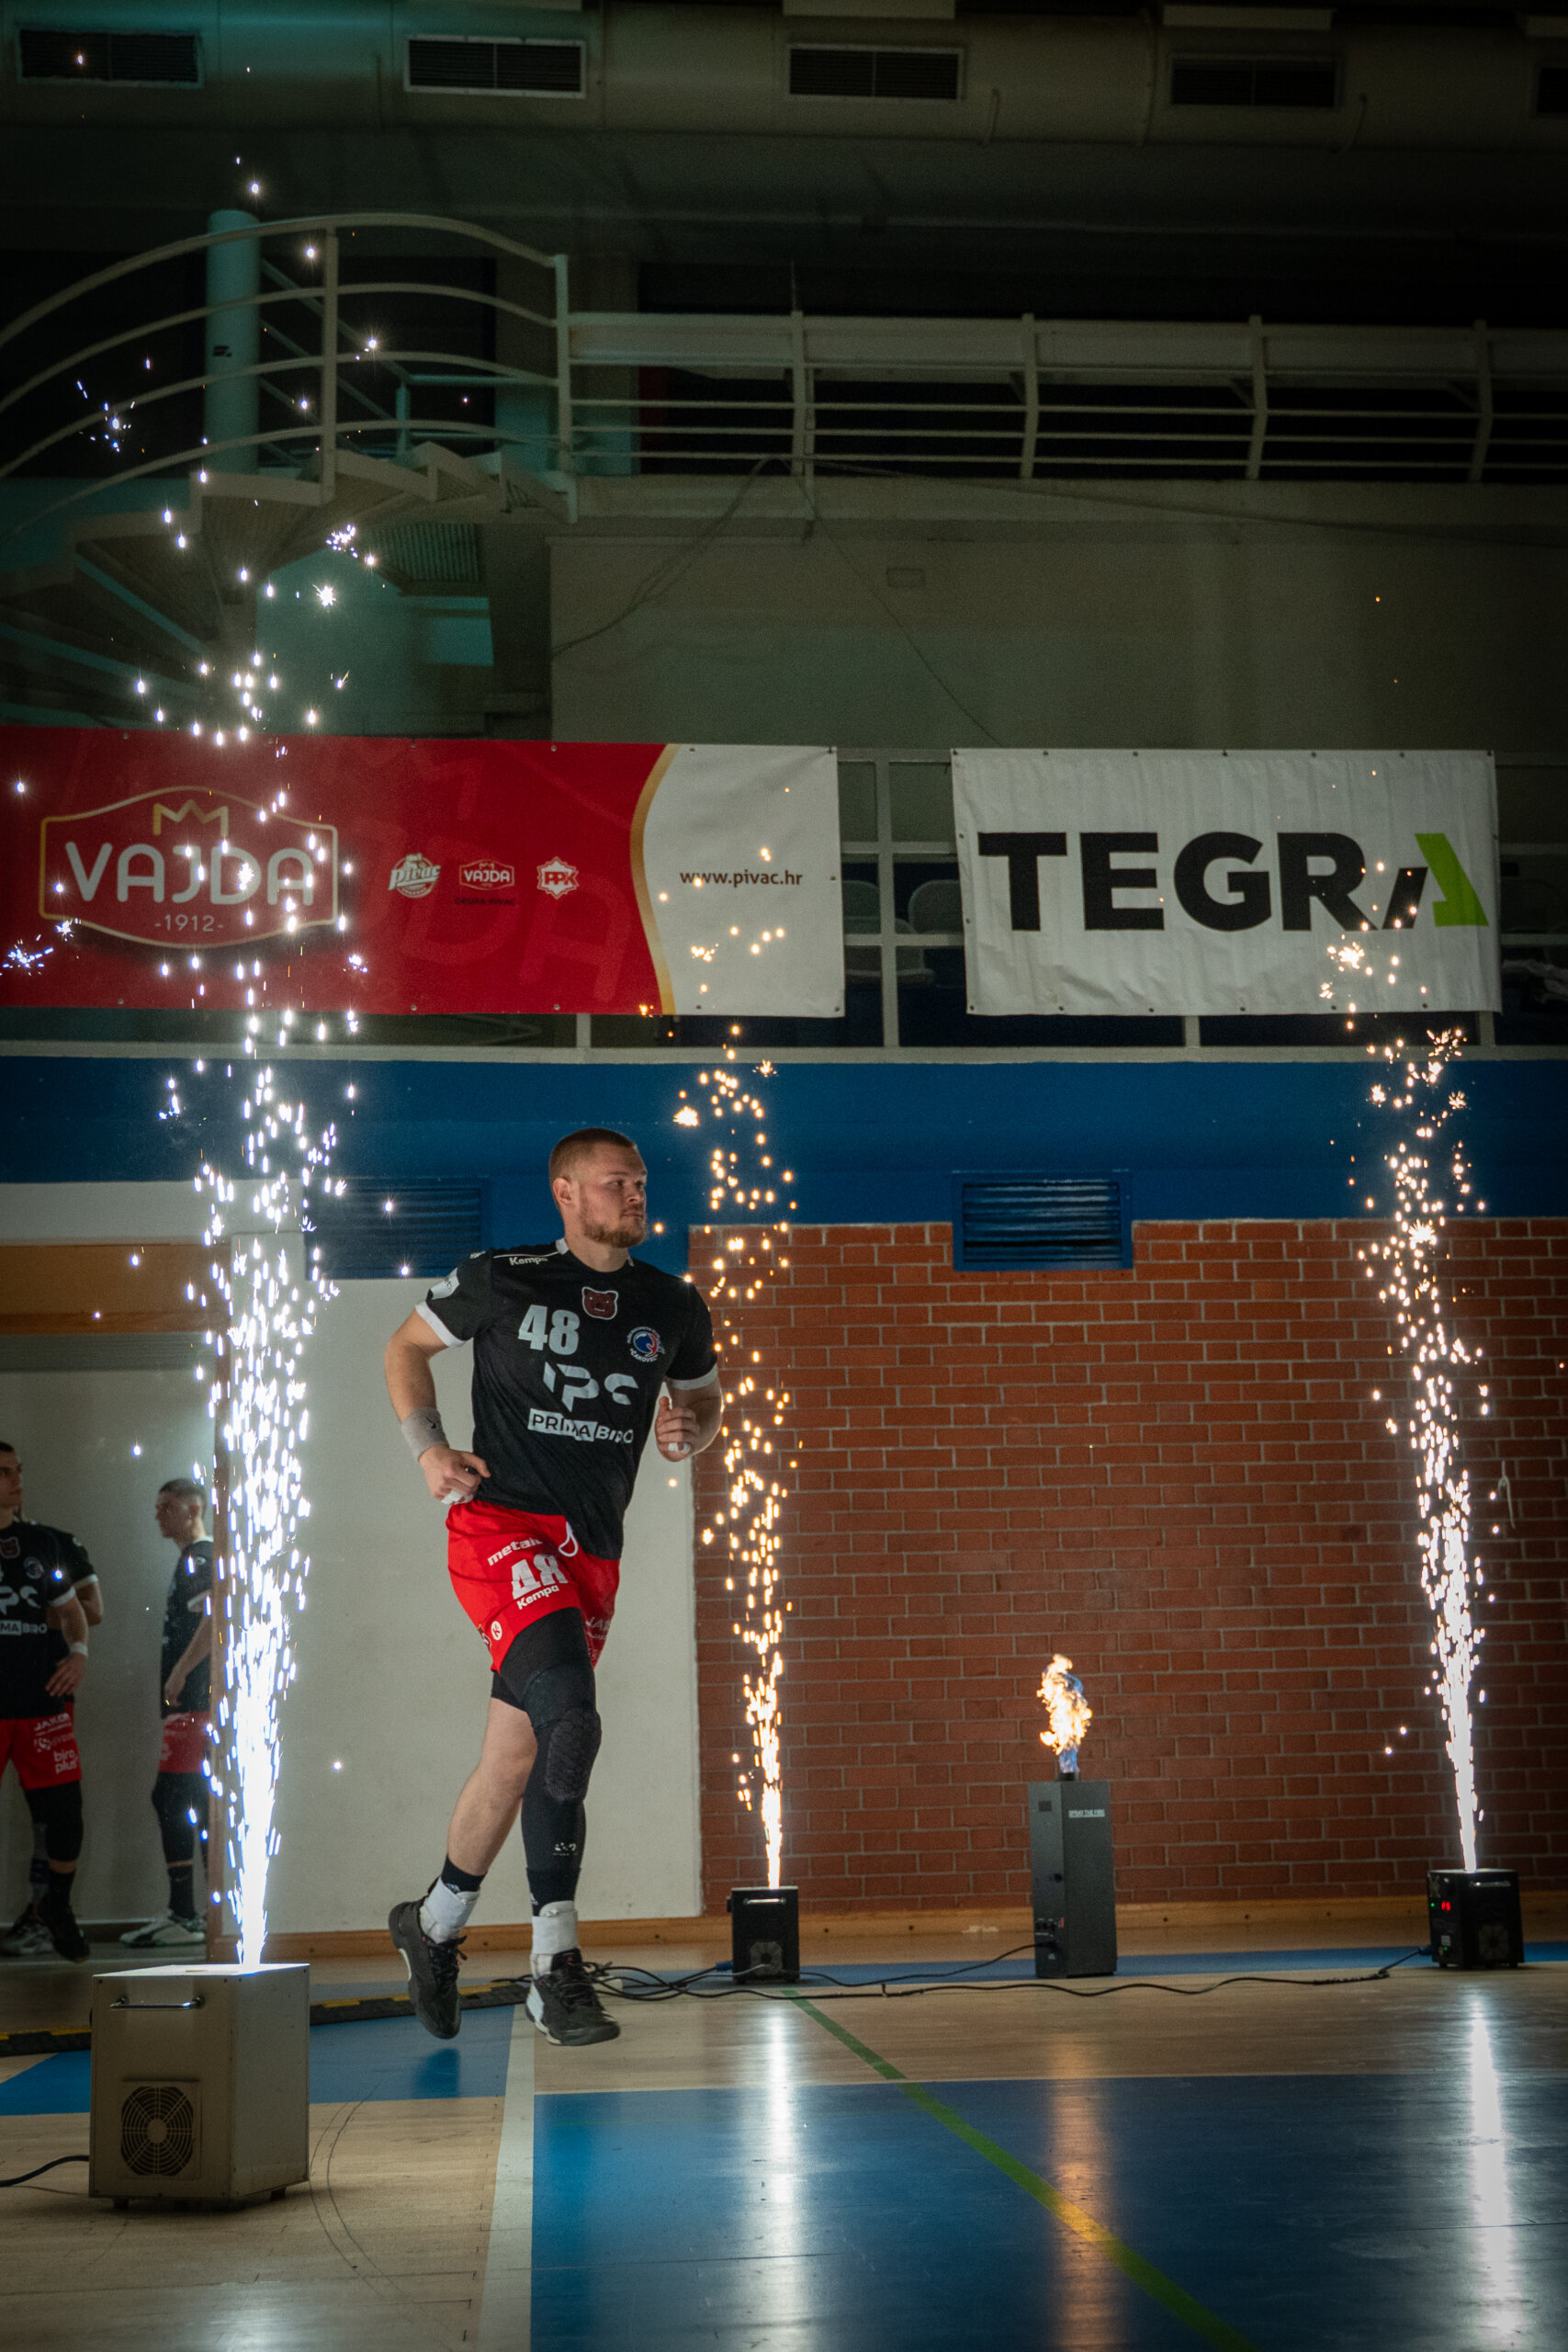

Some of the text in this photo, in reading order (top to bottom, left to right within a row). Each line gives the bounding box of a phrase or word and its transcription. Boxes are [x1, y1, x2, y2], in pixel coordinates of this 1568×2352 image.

[65, 842, 313, 905] VAJDA
[464, 870, 510, 883] VAJDA
[680, 869, 804, 888] www.pivac.hr
[977, 831, 1489, 932] TEGRA
[509, 1257, 548, 1266] Kempa
[517, 1305, 581, 1356] 48
[516, 1584, 559, 1611] Kempa
